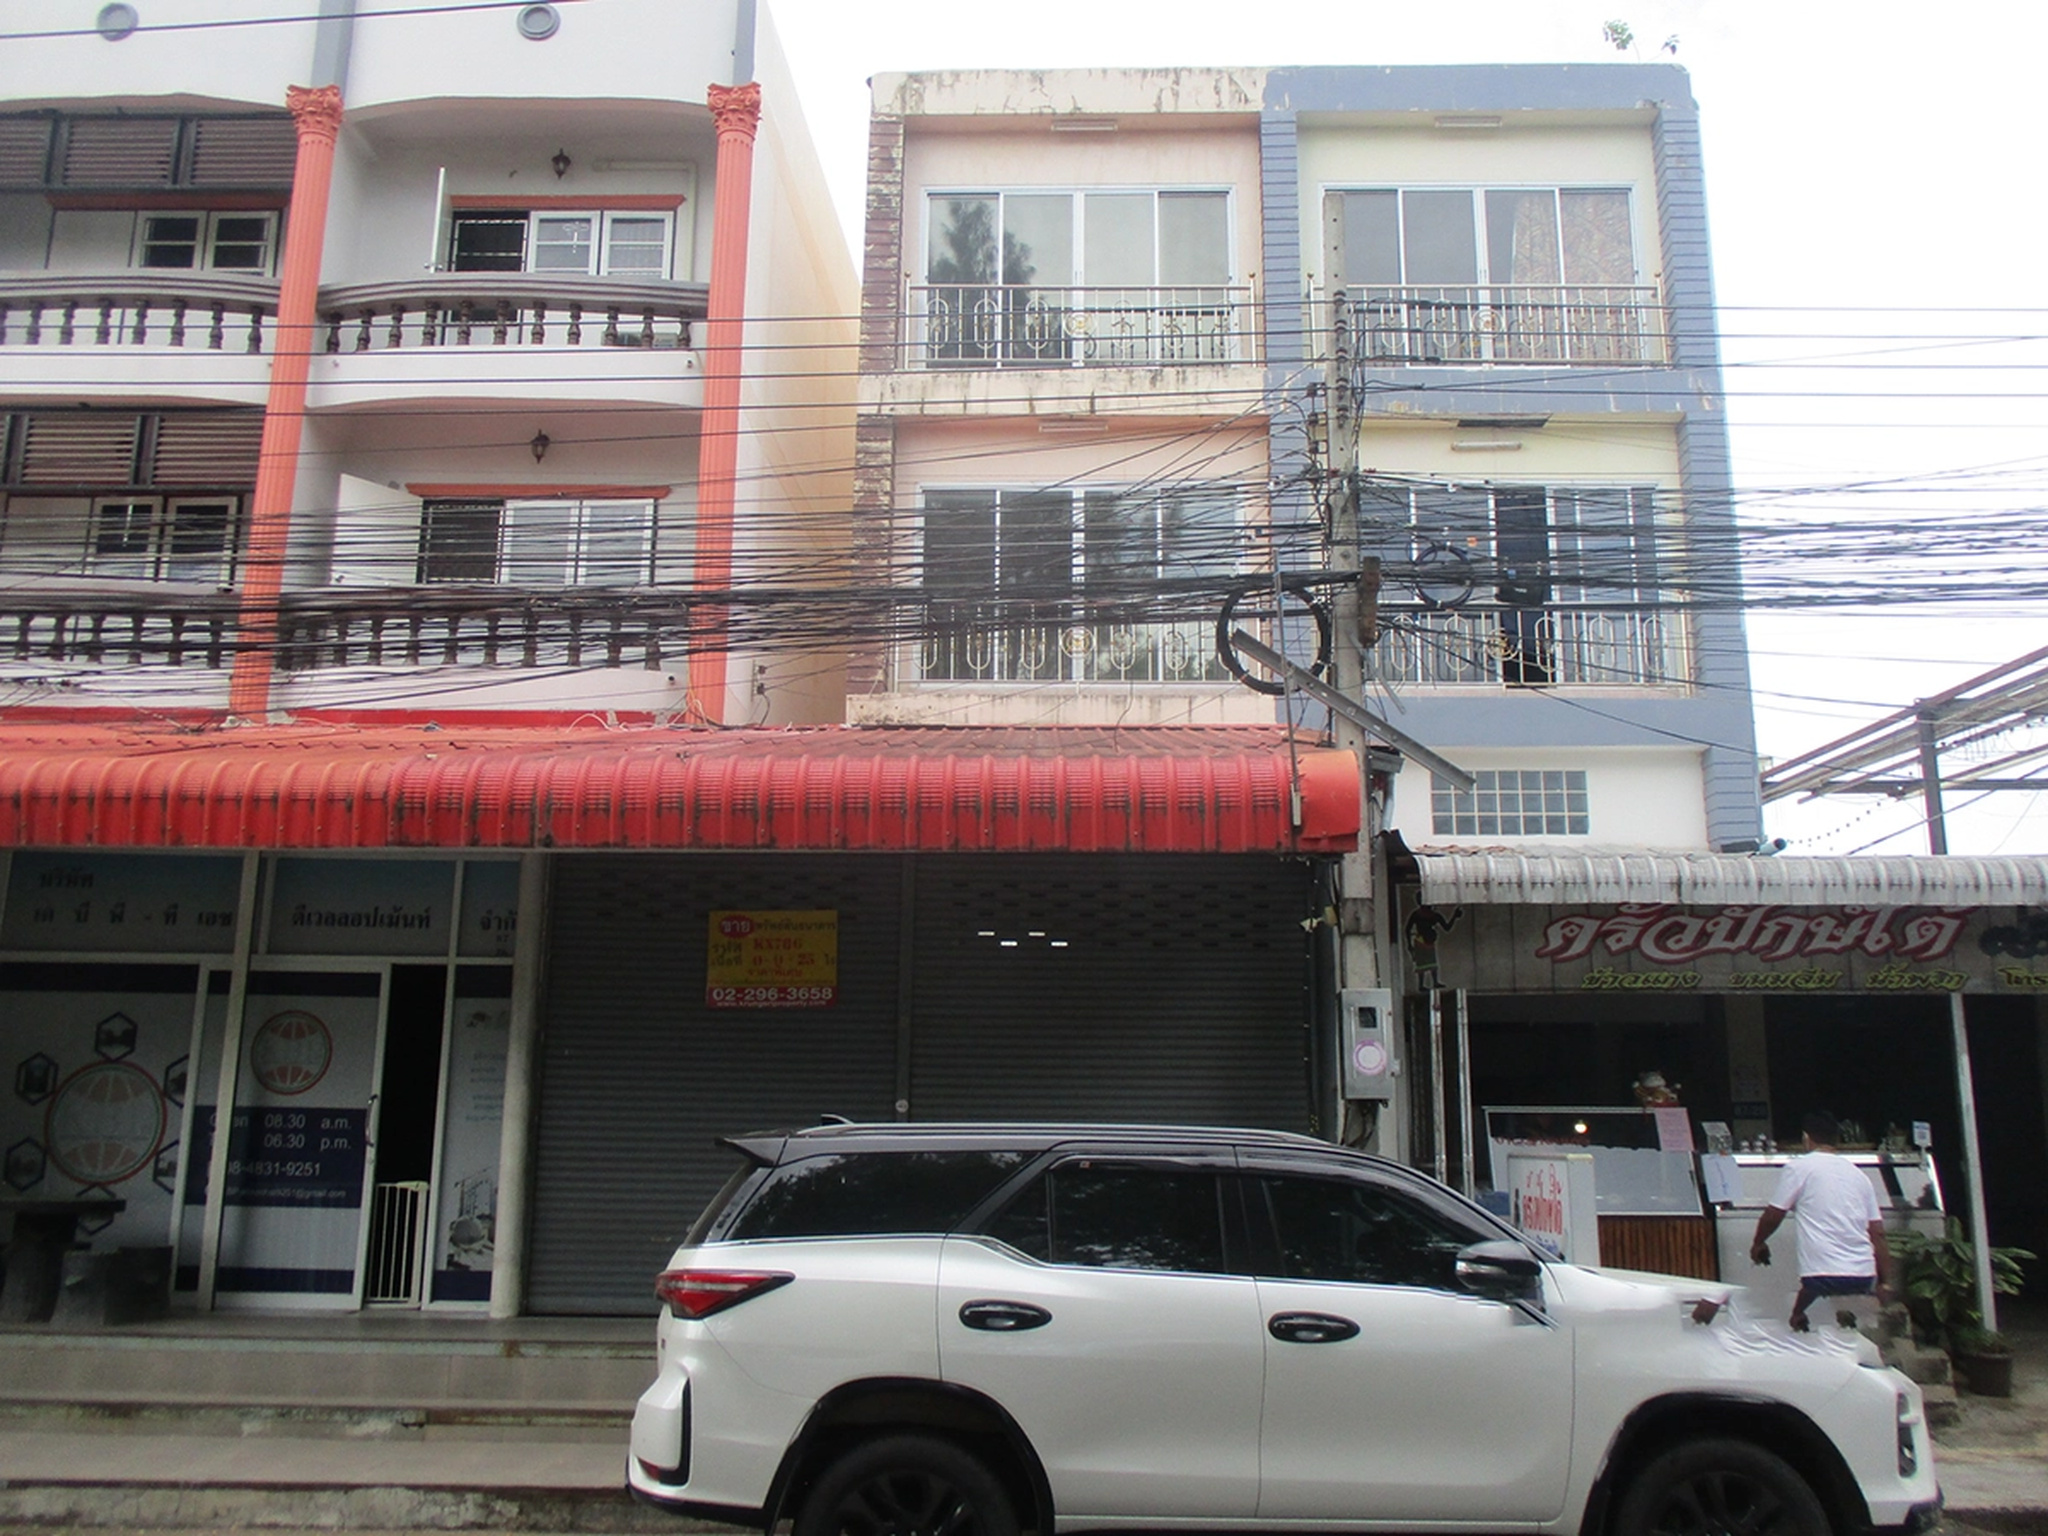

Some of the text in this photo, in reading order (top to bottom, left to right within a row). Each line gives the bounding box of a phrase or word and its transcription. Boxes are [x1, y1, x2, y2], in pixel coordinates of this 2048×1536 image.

[480, 908, 518, 931] จำกั
[720, 919, 751, 933] ขาย
[712, 986, 833, 1001] 02-296-3658
[264, 1113, 307, 1129] 08.30
[320, 1116, 352, 1130] a.m.
[263, 1132, 352, 1152] 06.30 p.m.
